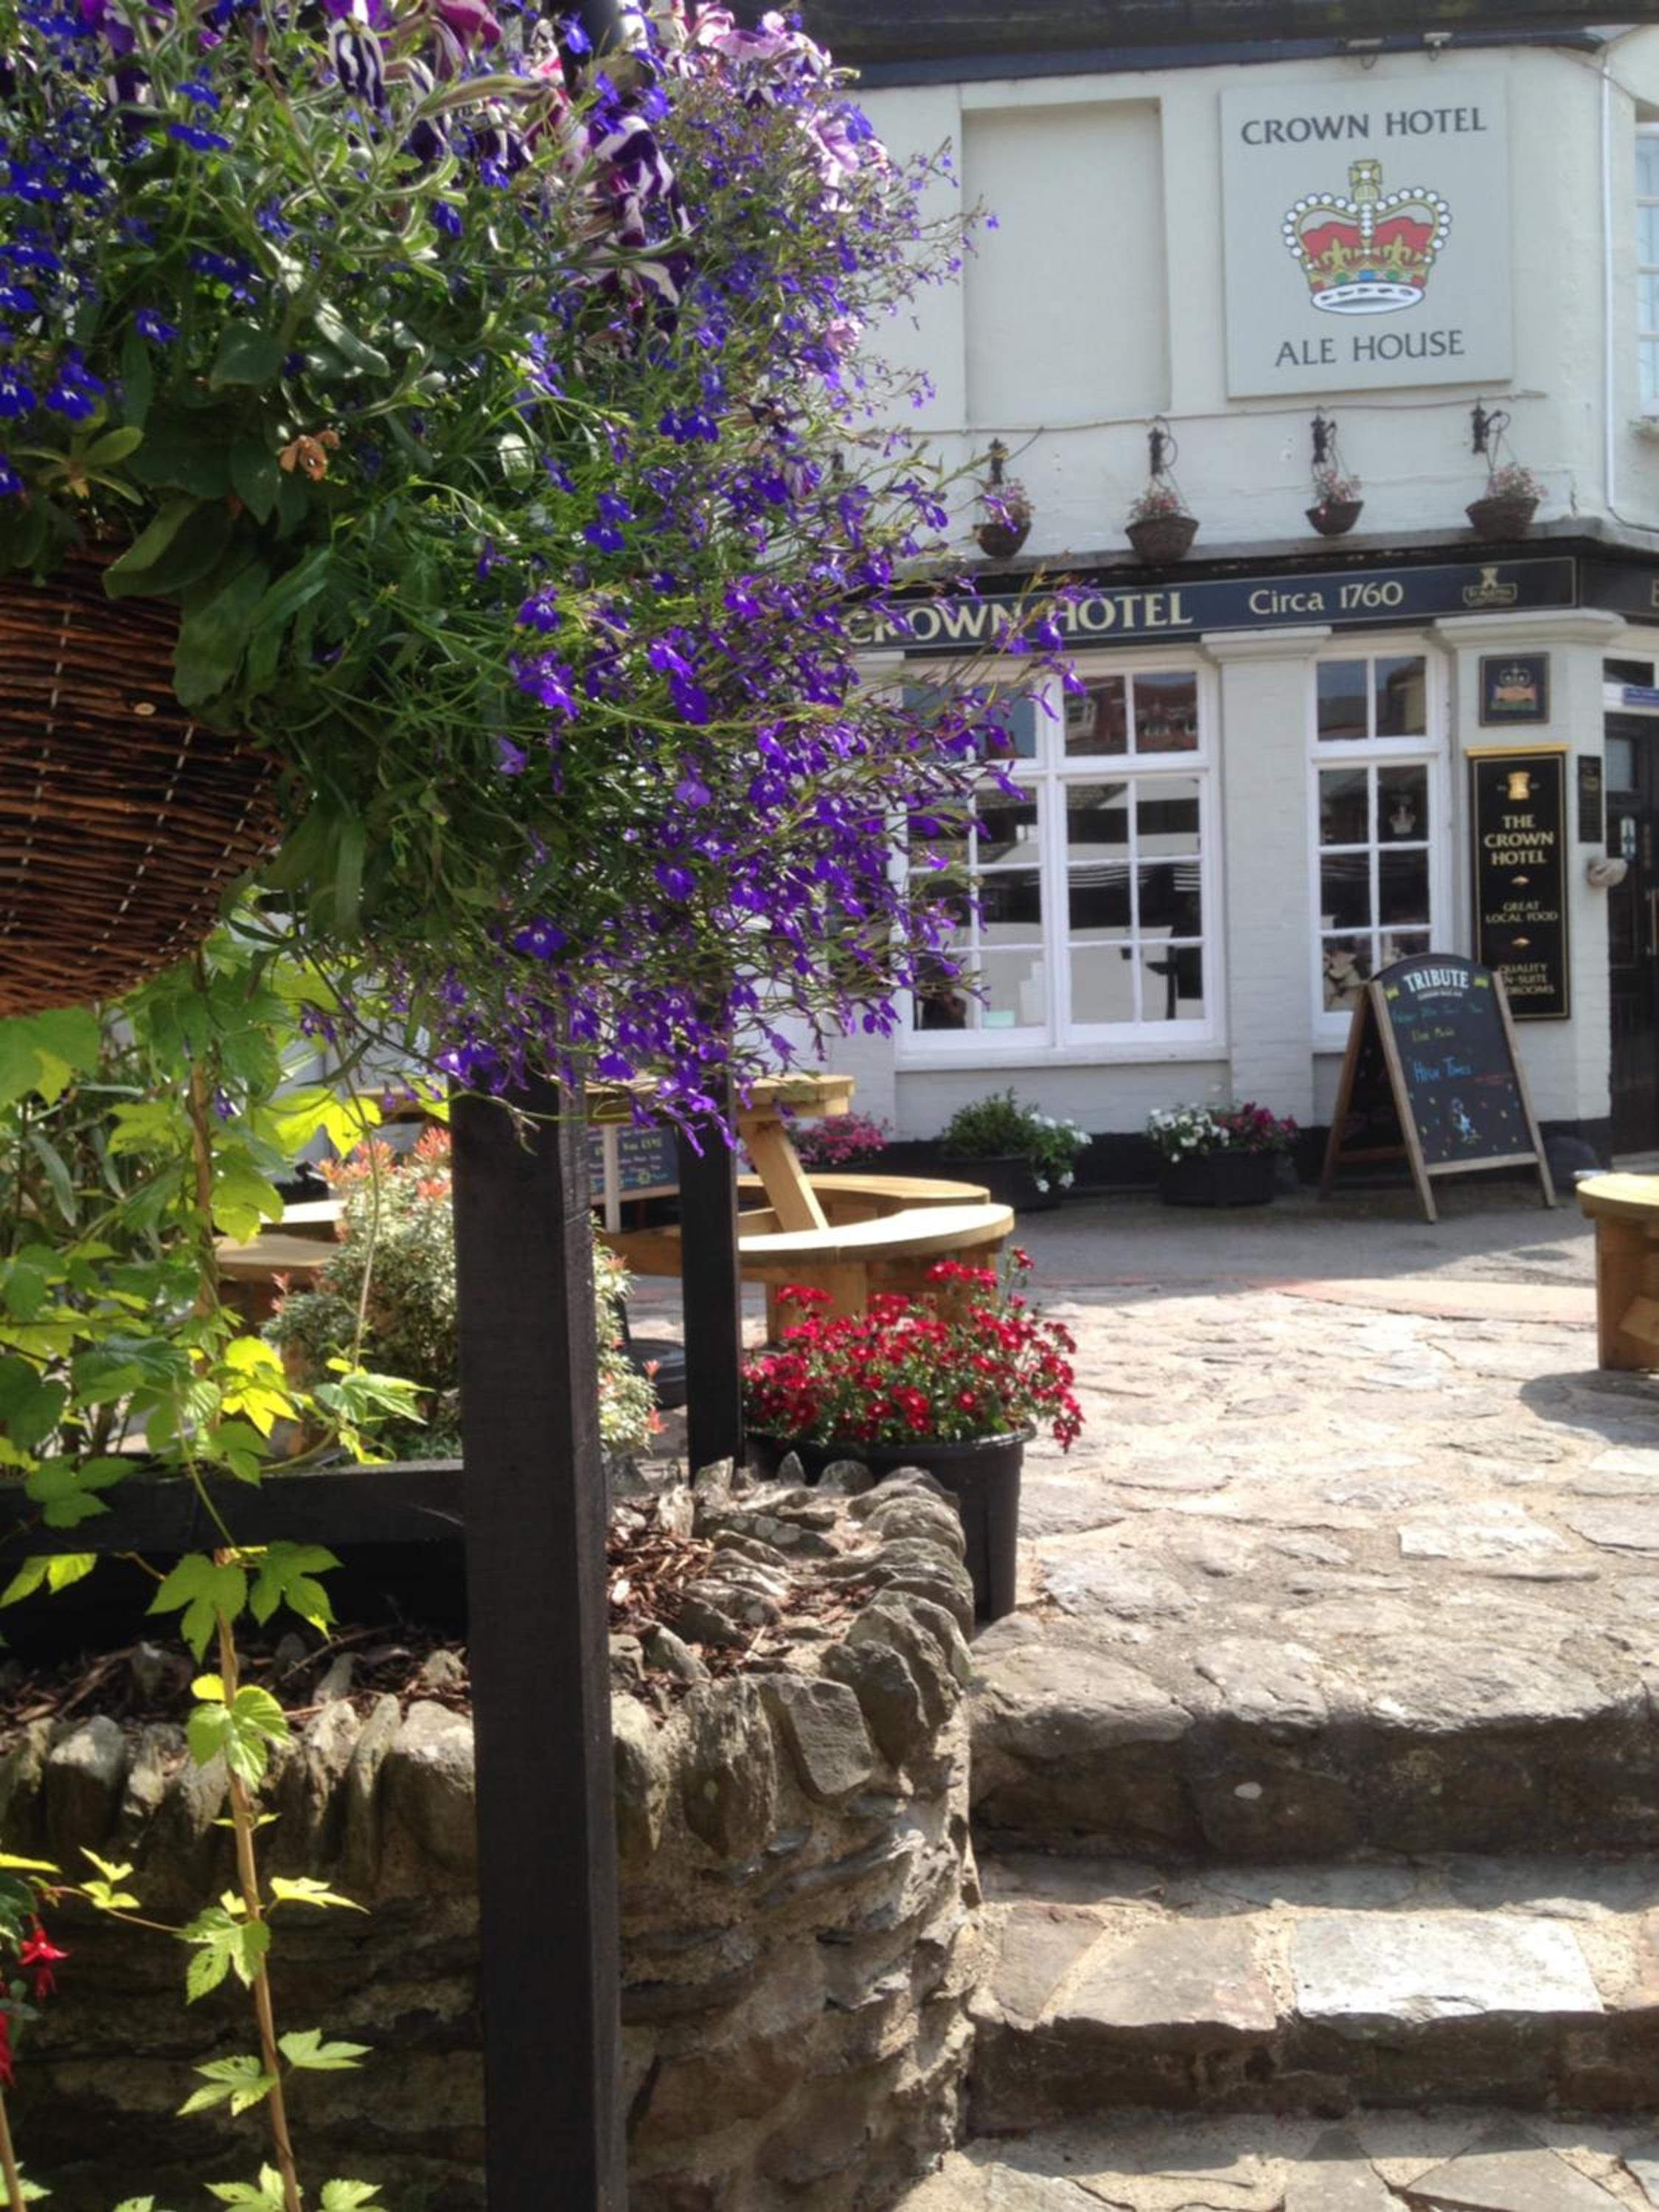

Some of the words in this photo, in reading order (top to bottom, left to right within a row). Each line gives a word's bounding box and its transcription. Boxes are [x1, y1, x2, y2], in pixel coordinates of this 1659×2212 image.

[1241, 114, 1371, 146] CROWN
[1386, 107, 1487, 137] HOTEL
[1275, 338, 1336, 368] ALE
[1352, 330, 1465, 362] HOUSE
[1248, 589, 1326, 614] Circa
[1340, 580, 1404, 609] 1760
[1047, 591, 1193, 631] HOTEL
[1501, 813, 1535, 829] THE
[1484, 831, 1554, 849] CROWN
[1491, 849, 1548, 866] HOTEL
[1503, 900, 1540, 912] GREAT
[1486, 913, 1522, 923] LOCAL
[1526, 911, 1558, 922] FOOD
[1403, 968, 1469, 993] TRIBUTE
